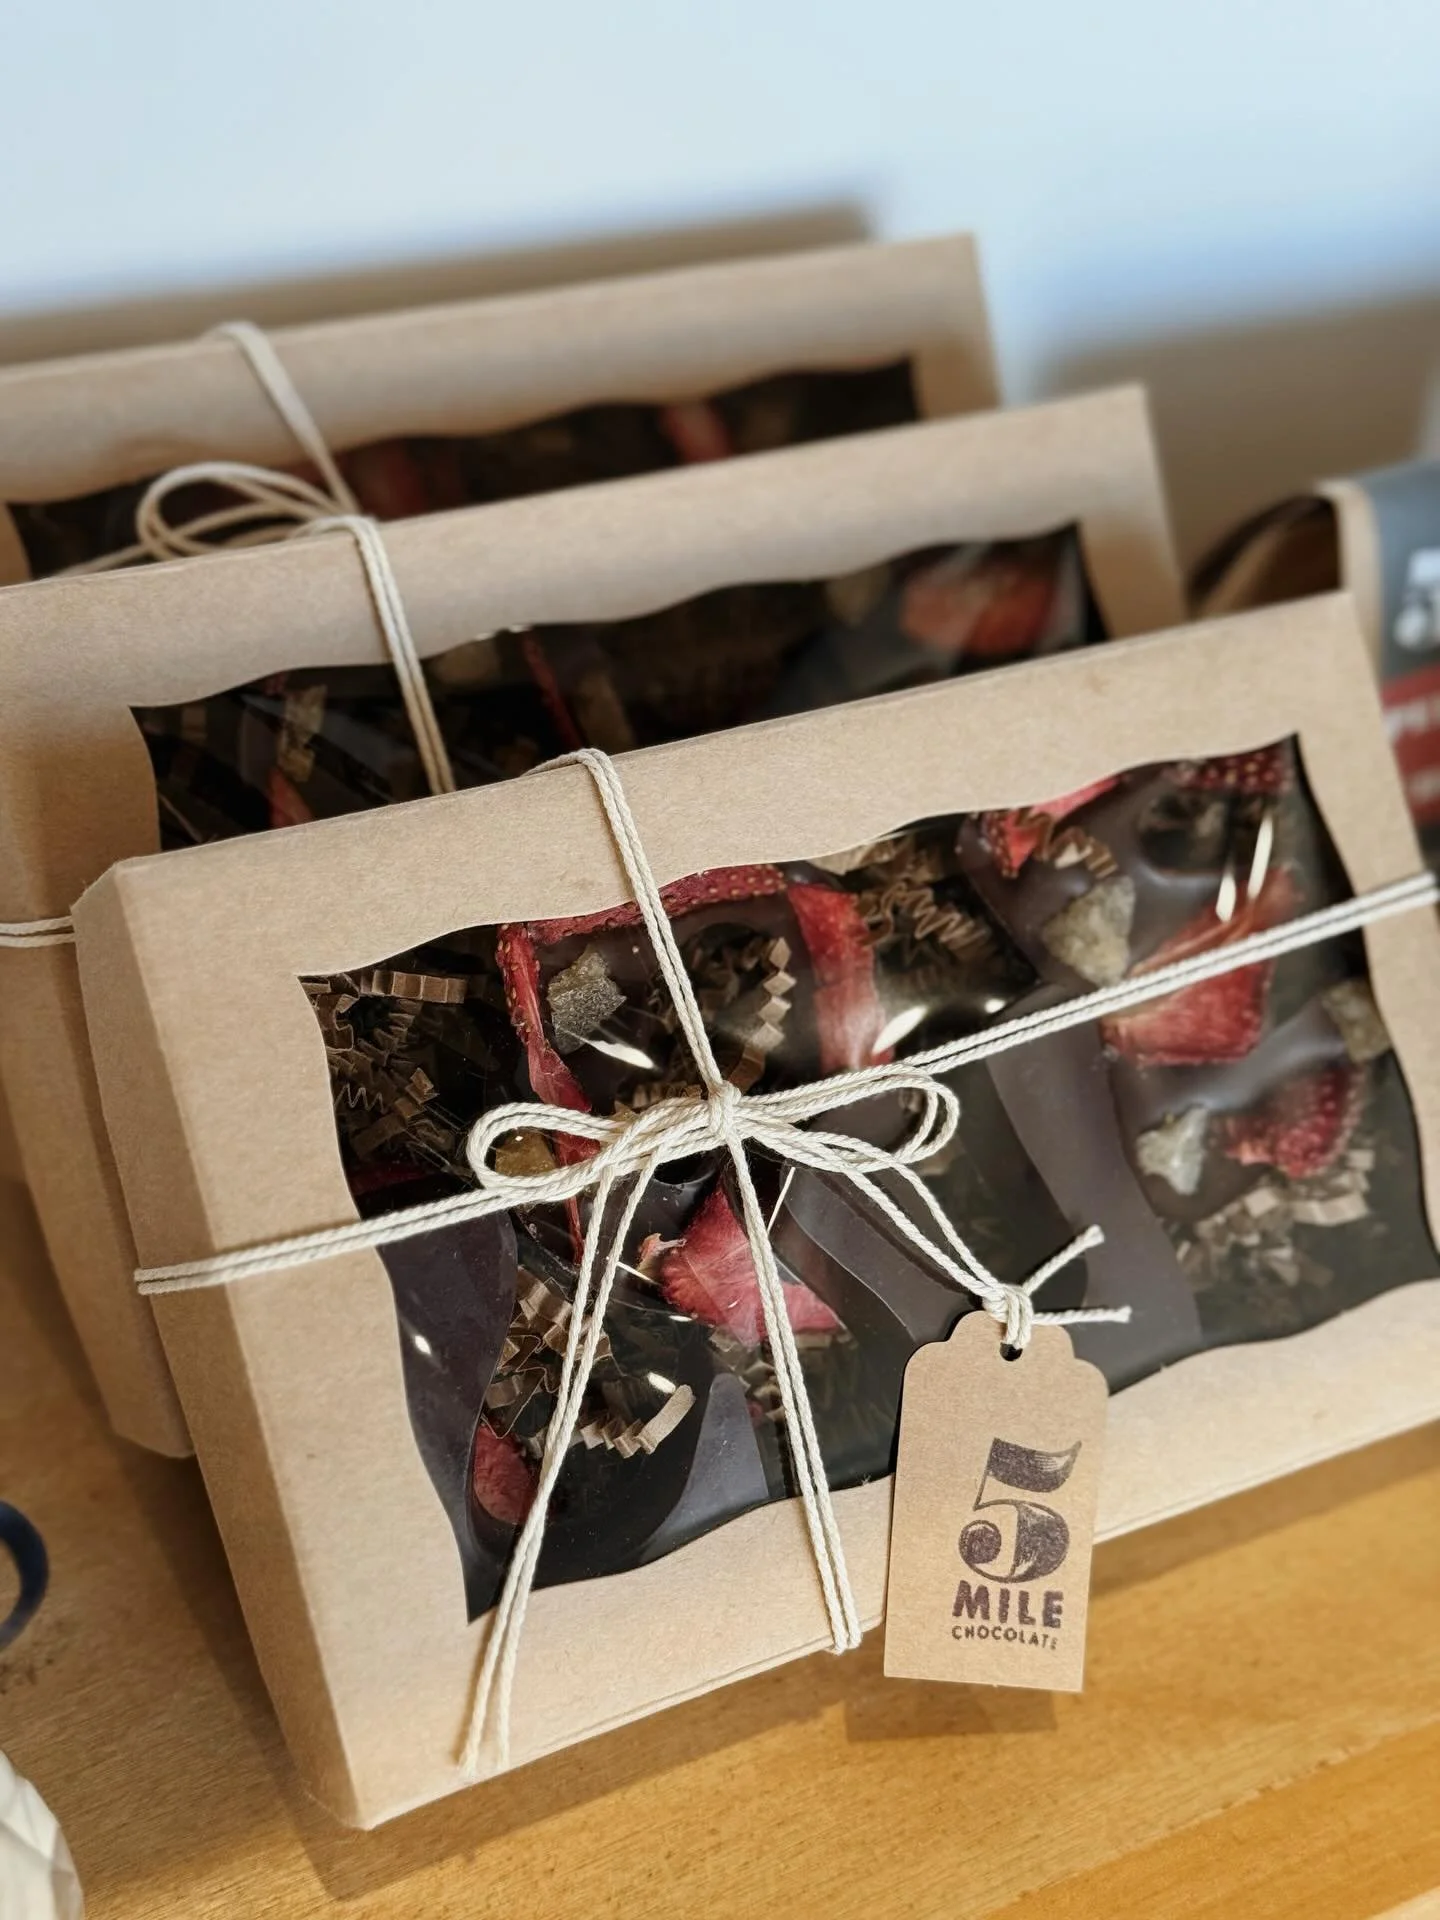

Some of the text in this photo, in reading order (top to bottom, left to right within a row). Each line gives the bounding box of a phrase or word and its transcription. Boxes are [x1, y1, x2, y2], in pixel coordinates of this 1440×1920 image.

[959, 1437, 1082, 1584] 5
[952, 1580, 1064, 1629] MILE
[951, 1625, 1058, 1650] CHOCOLATE
